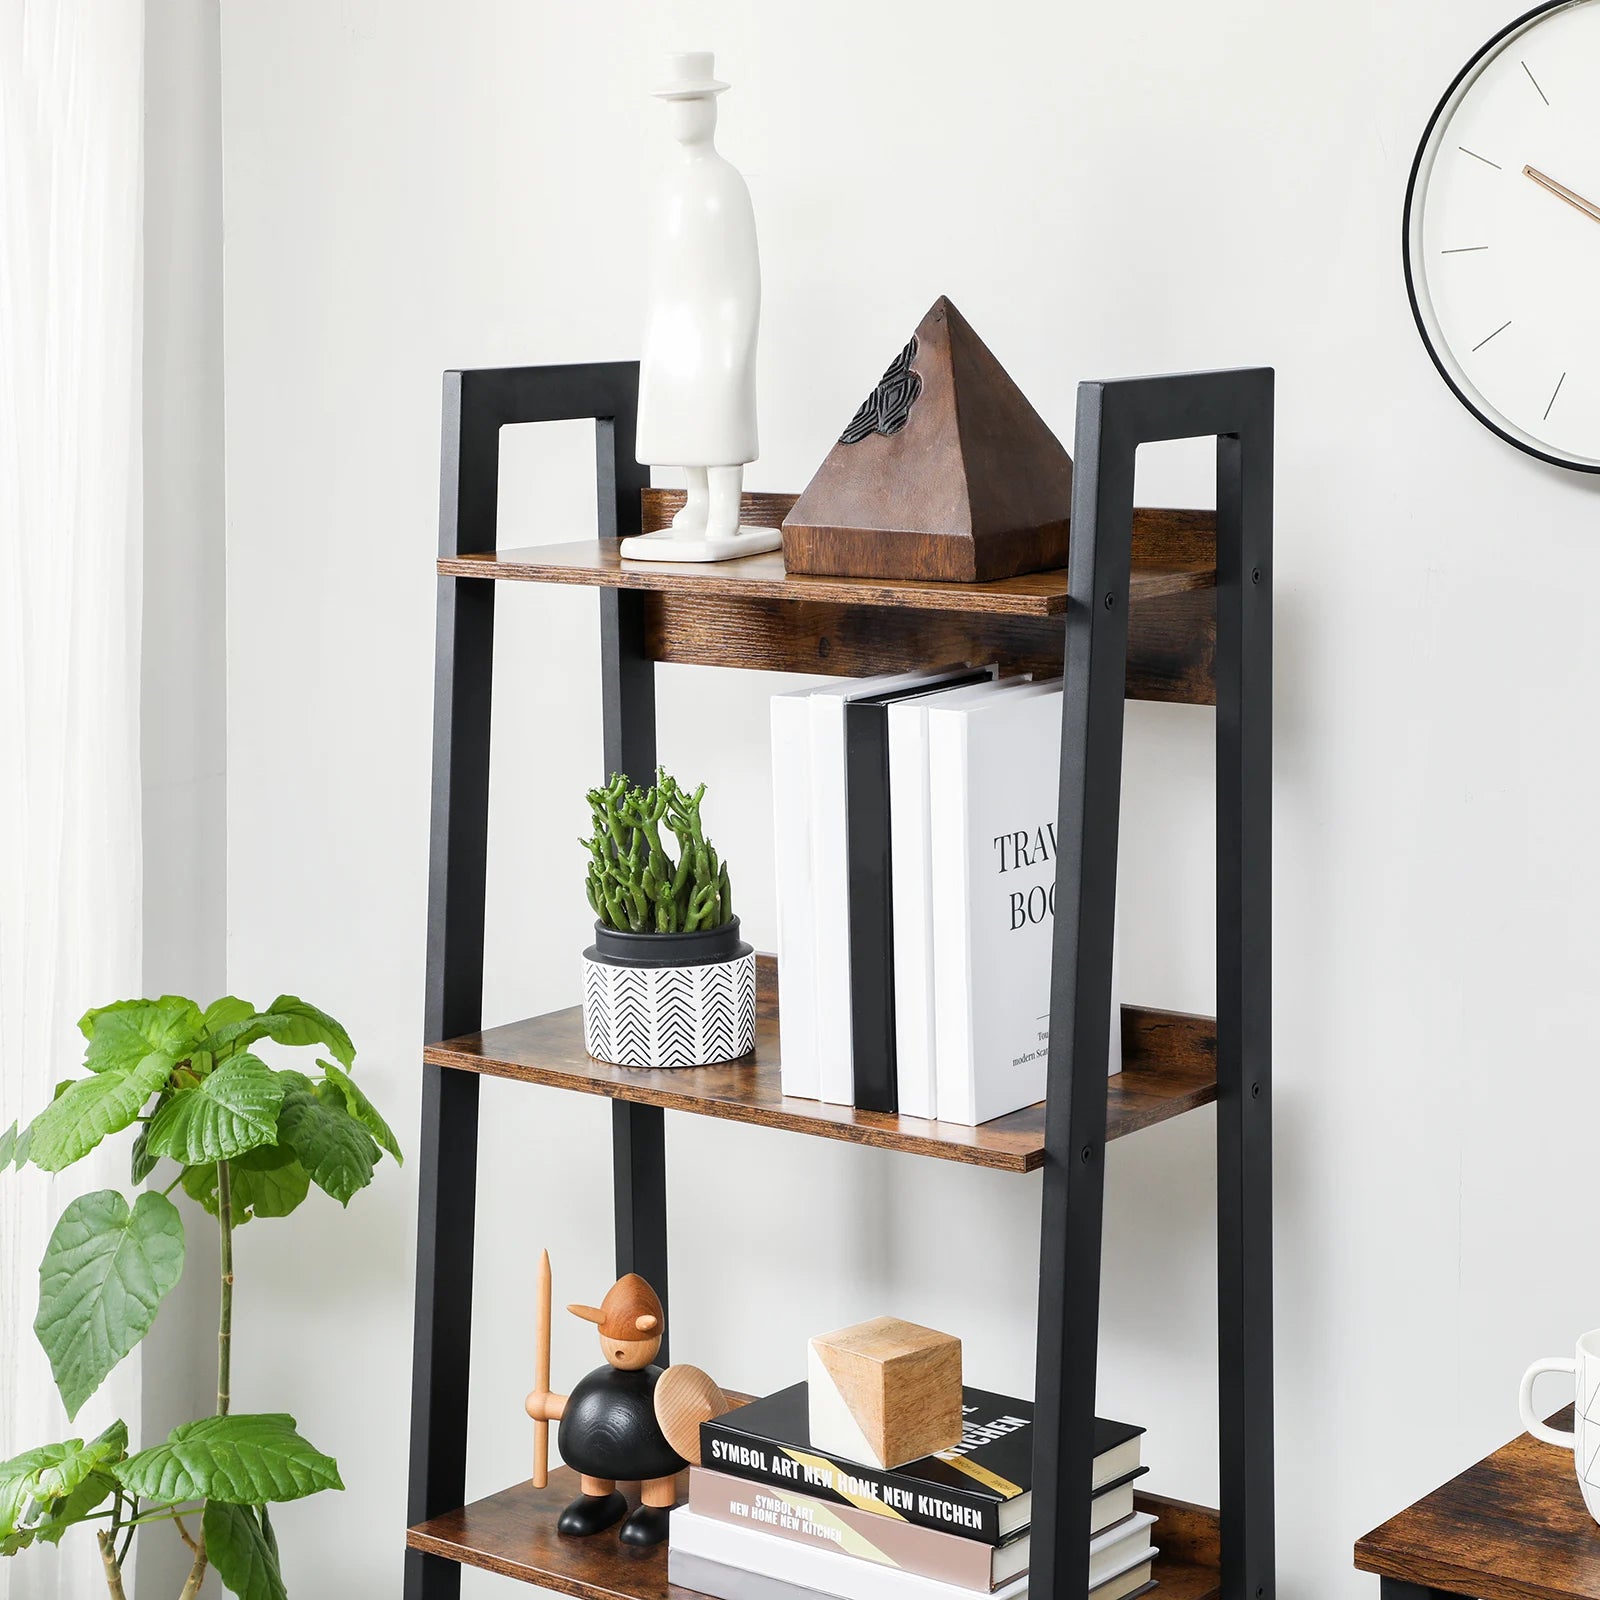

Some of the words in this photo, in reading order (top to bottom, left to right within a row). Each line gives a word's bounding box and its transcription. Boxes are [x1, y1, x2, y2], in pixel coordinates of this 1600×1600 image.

[1012, 1053, 1036, 1067] modern
[711, 1439, 768, 1471] SYMBOL
[771, 1455, 800, 1480] ART
[803, 1464, 833, 1489] NEW
[838, 1472, 879, 1500] HOME
[883, 1485, 914, 1512] NEW
[918, 1494, 983, 1531] KITCHEN
[729, 1500, 749, 1518] NEW
[751, 1507, 778, 1526] HOME
[780, 1514, 800, 1532] NEW
[802, 1520, 843, 1543] KITCHEN
[755, 1494, 793, 1516] SYMBOL
[795, 1504, 814, 1522] ART
